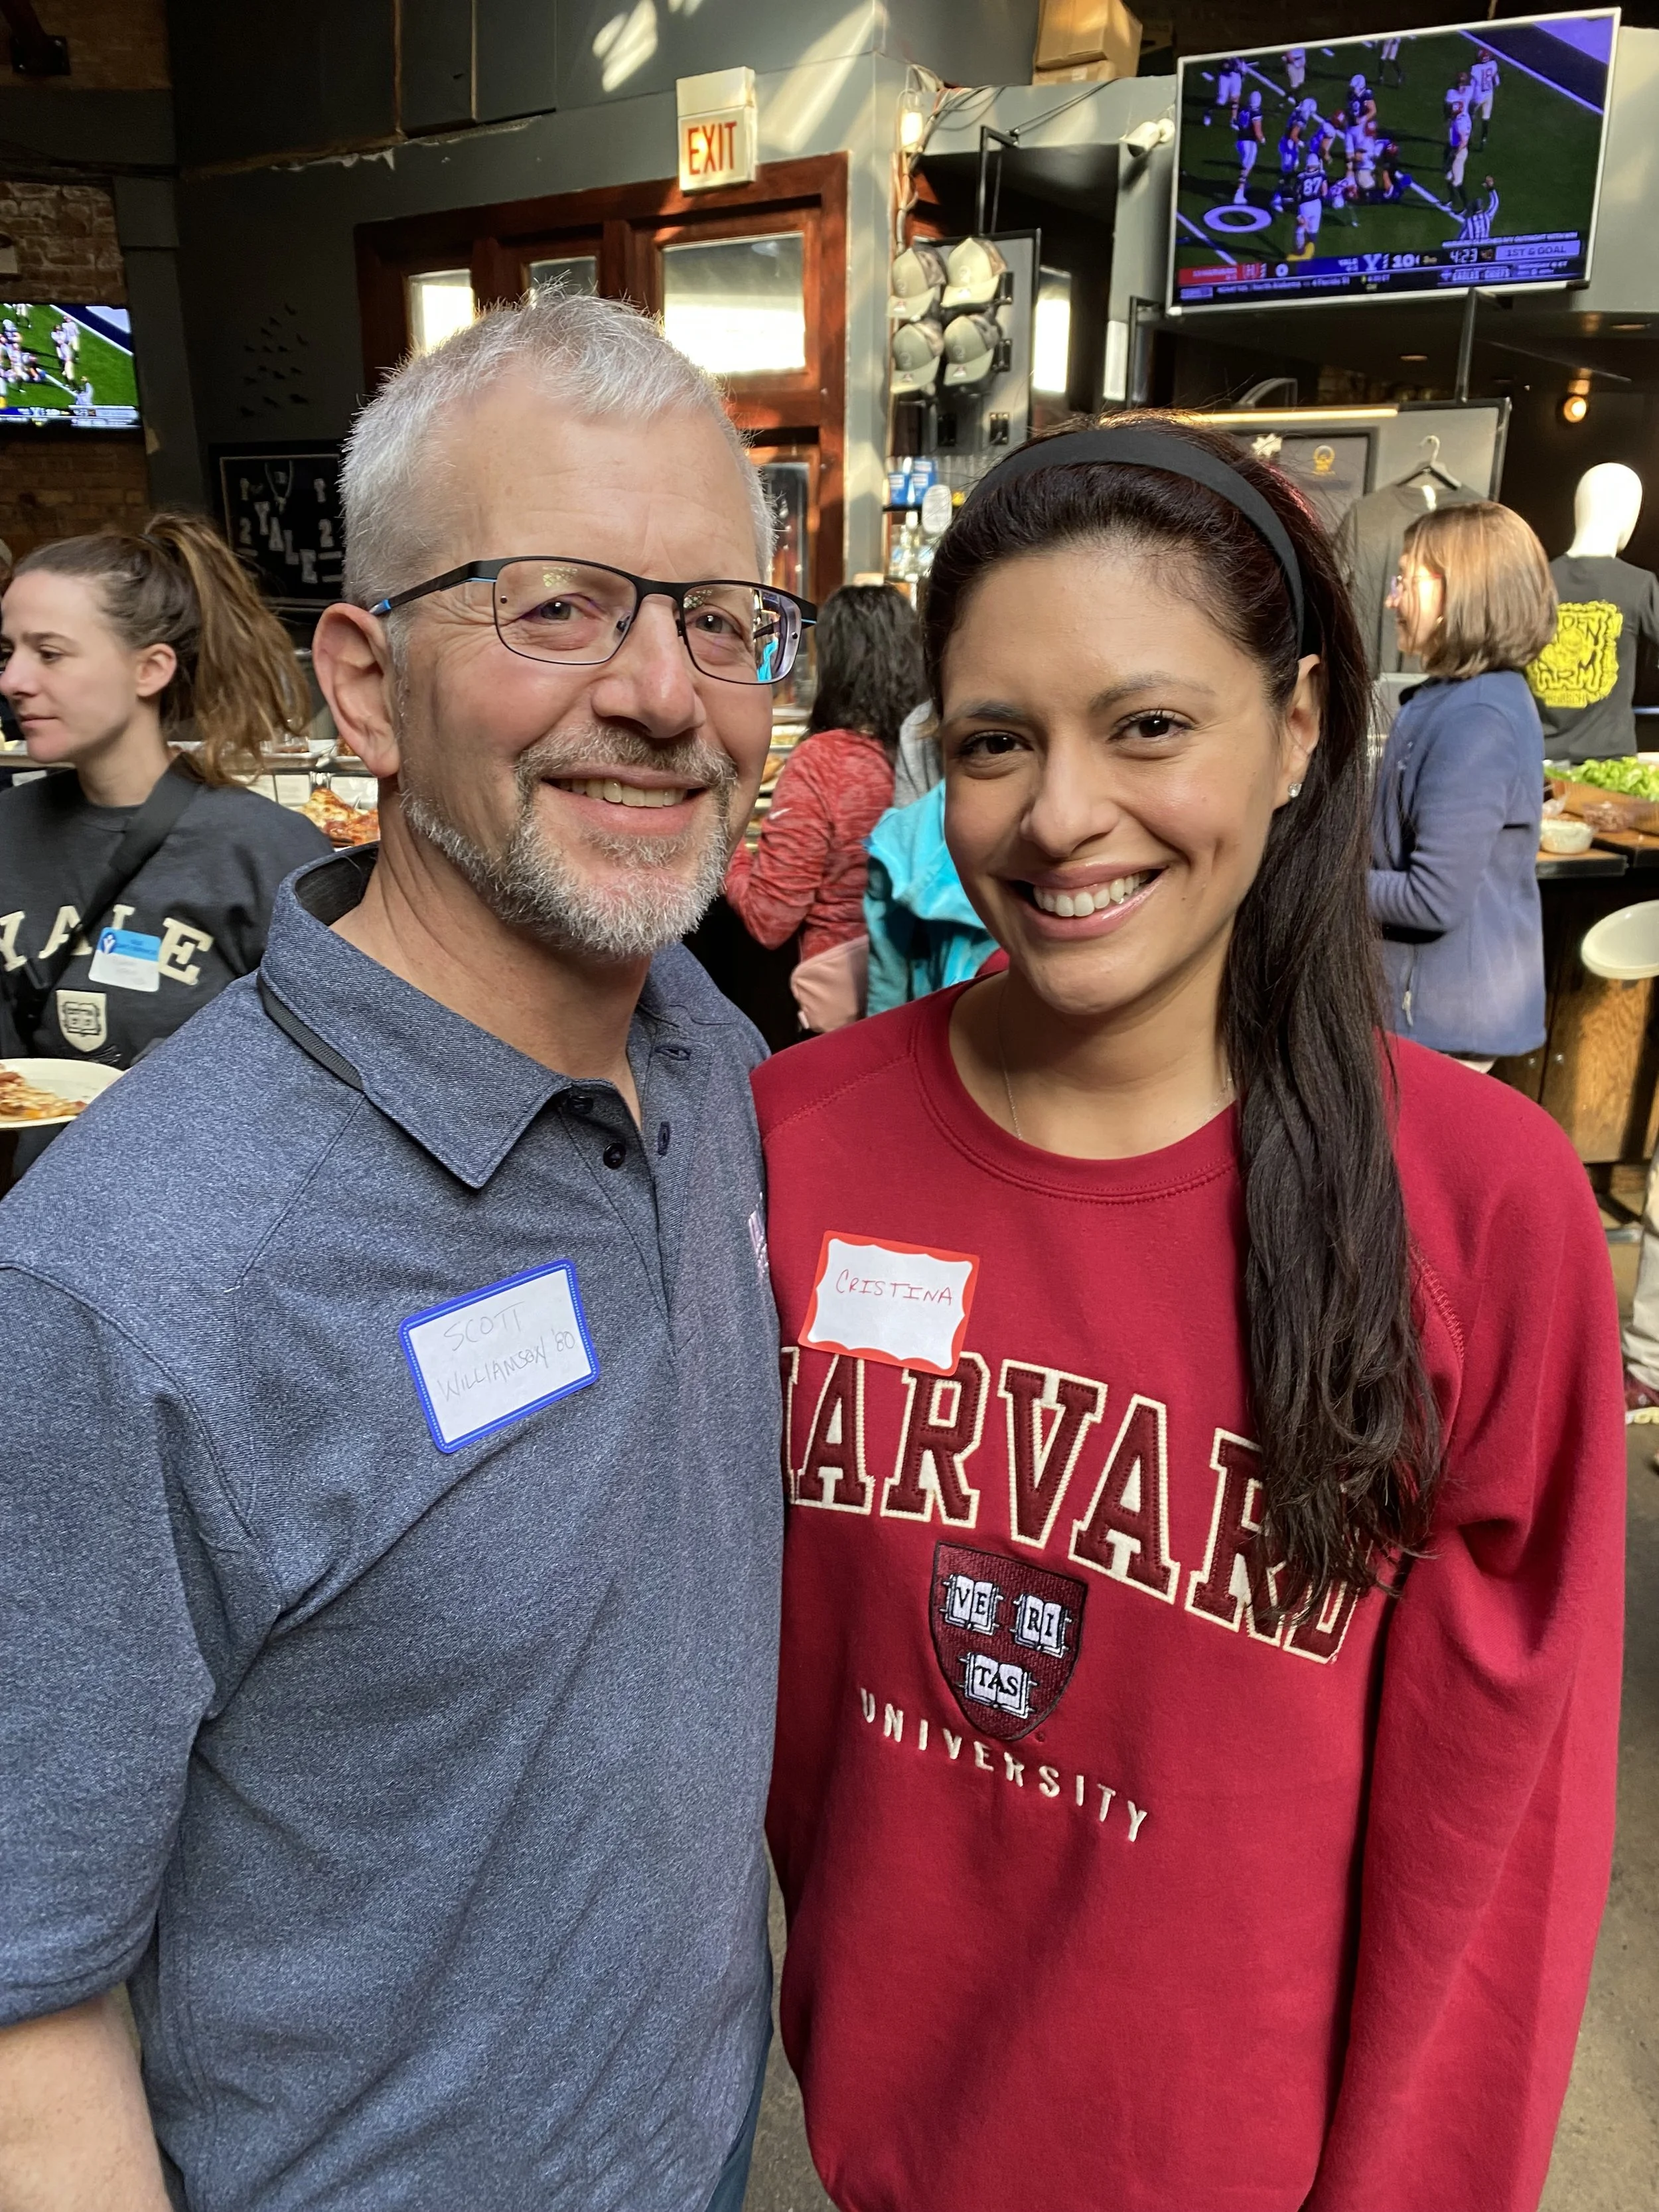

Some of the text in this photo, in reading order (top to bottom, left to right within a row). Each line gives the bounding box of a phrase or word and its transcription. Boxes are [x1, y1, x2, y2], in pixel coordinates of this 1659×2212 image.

[688, 121, 737, 175] EXIT
[1303, 177, 1323, 196] 87
[1449, 248, 1478, 263] 4:23
[835, 1268, 953, 1306] CRISTINA
[443, 1301, 525, 1352] SCOTT
[955, 1586, 1054, 1637] VE RI
[974, 1664, 1019, 1697] TAS
[860, 1687, 1147, 1842] UNIVERSITY
